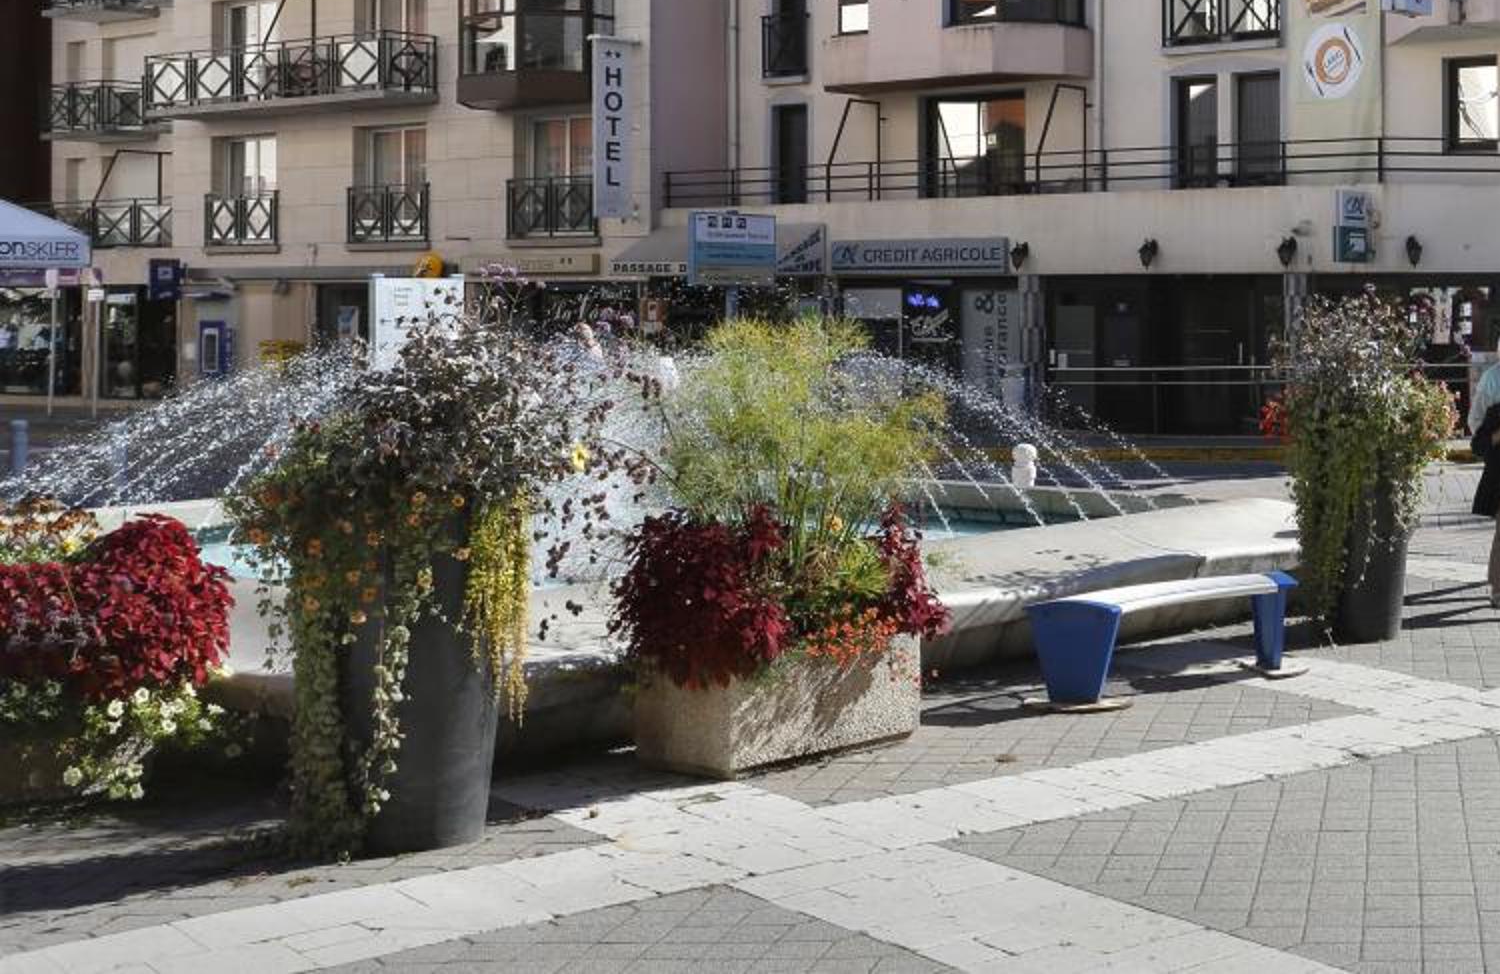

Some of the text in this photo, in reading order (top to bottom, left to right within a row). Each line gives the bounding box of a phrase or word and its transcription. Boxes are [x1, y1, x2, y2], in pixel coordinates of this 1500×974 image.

[603, 65, 623, 188] HOTEL
[922, 246, 1002, 262] AGRICOLE
[612, 262, 669, 274] PASSAGE
